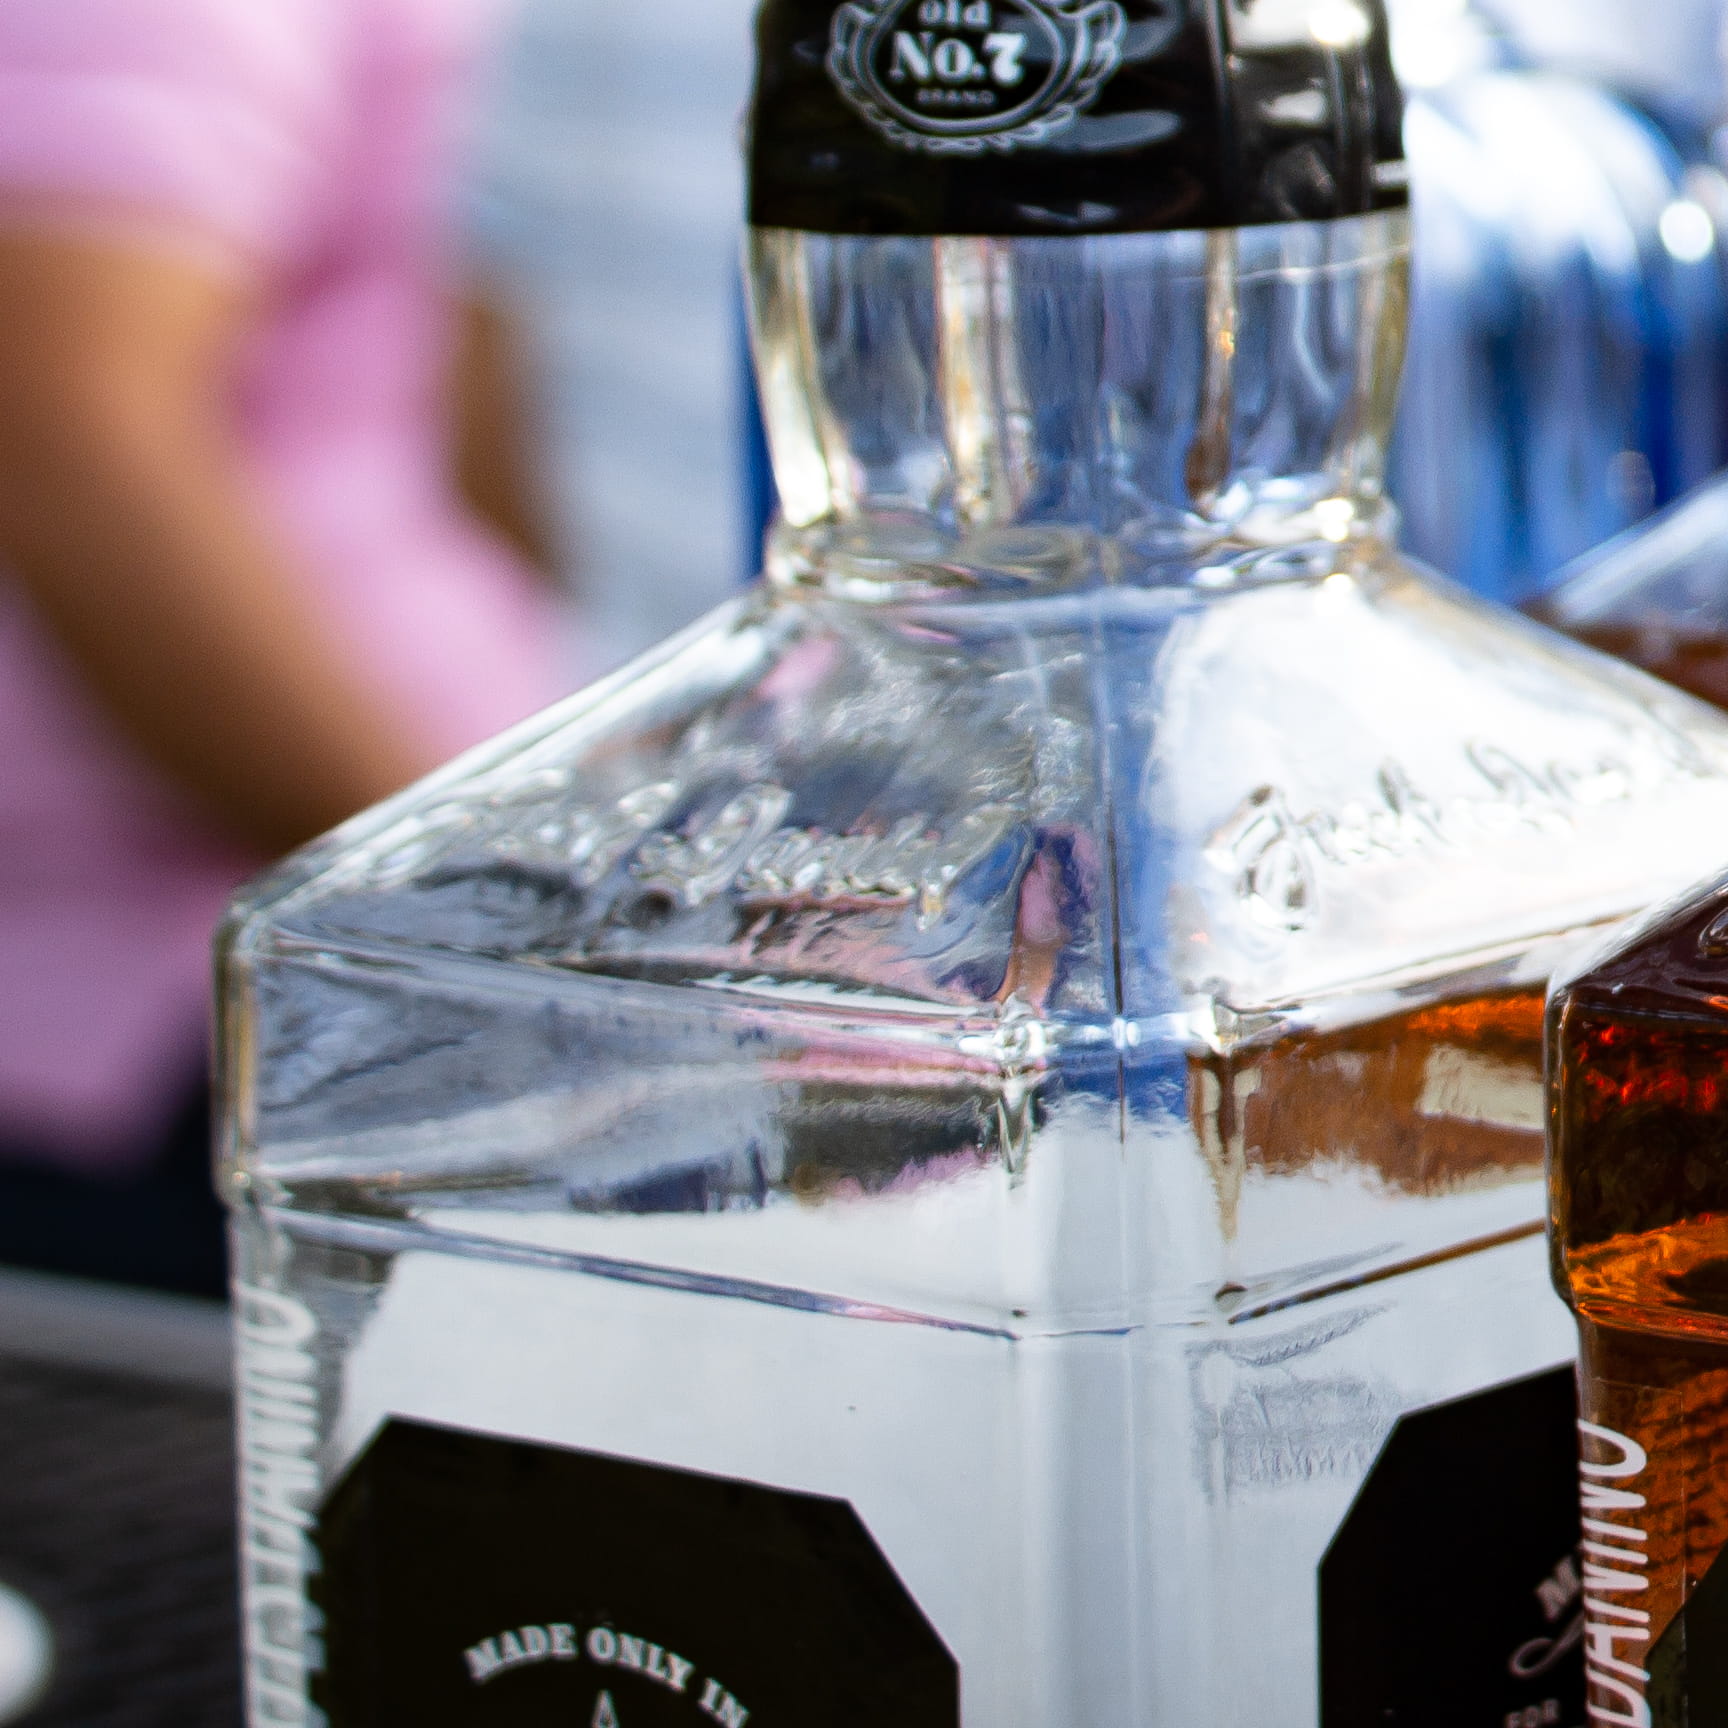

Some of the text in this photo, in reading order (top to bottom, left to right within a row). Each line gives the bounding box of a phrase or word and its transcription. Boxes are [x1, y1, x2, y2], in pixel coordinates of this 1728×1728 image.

[890, 31, 1027, 85] No.7
[464, 1623, 750, 1728] MADE ONLY IN
